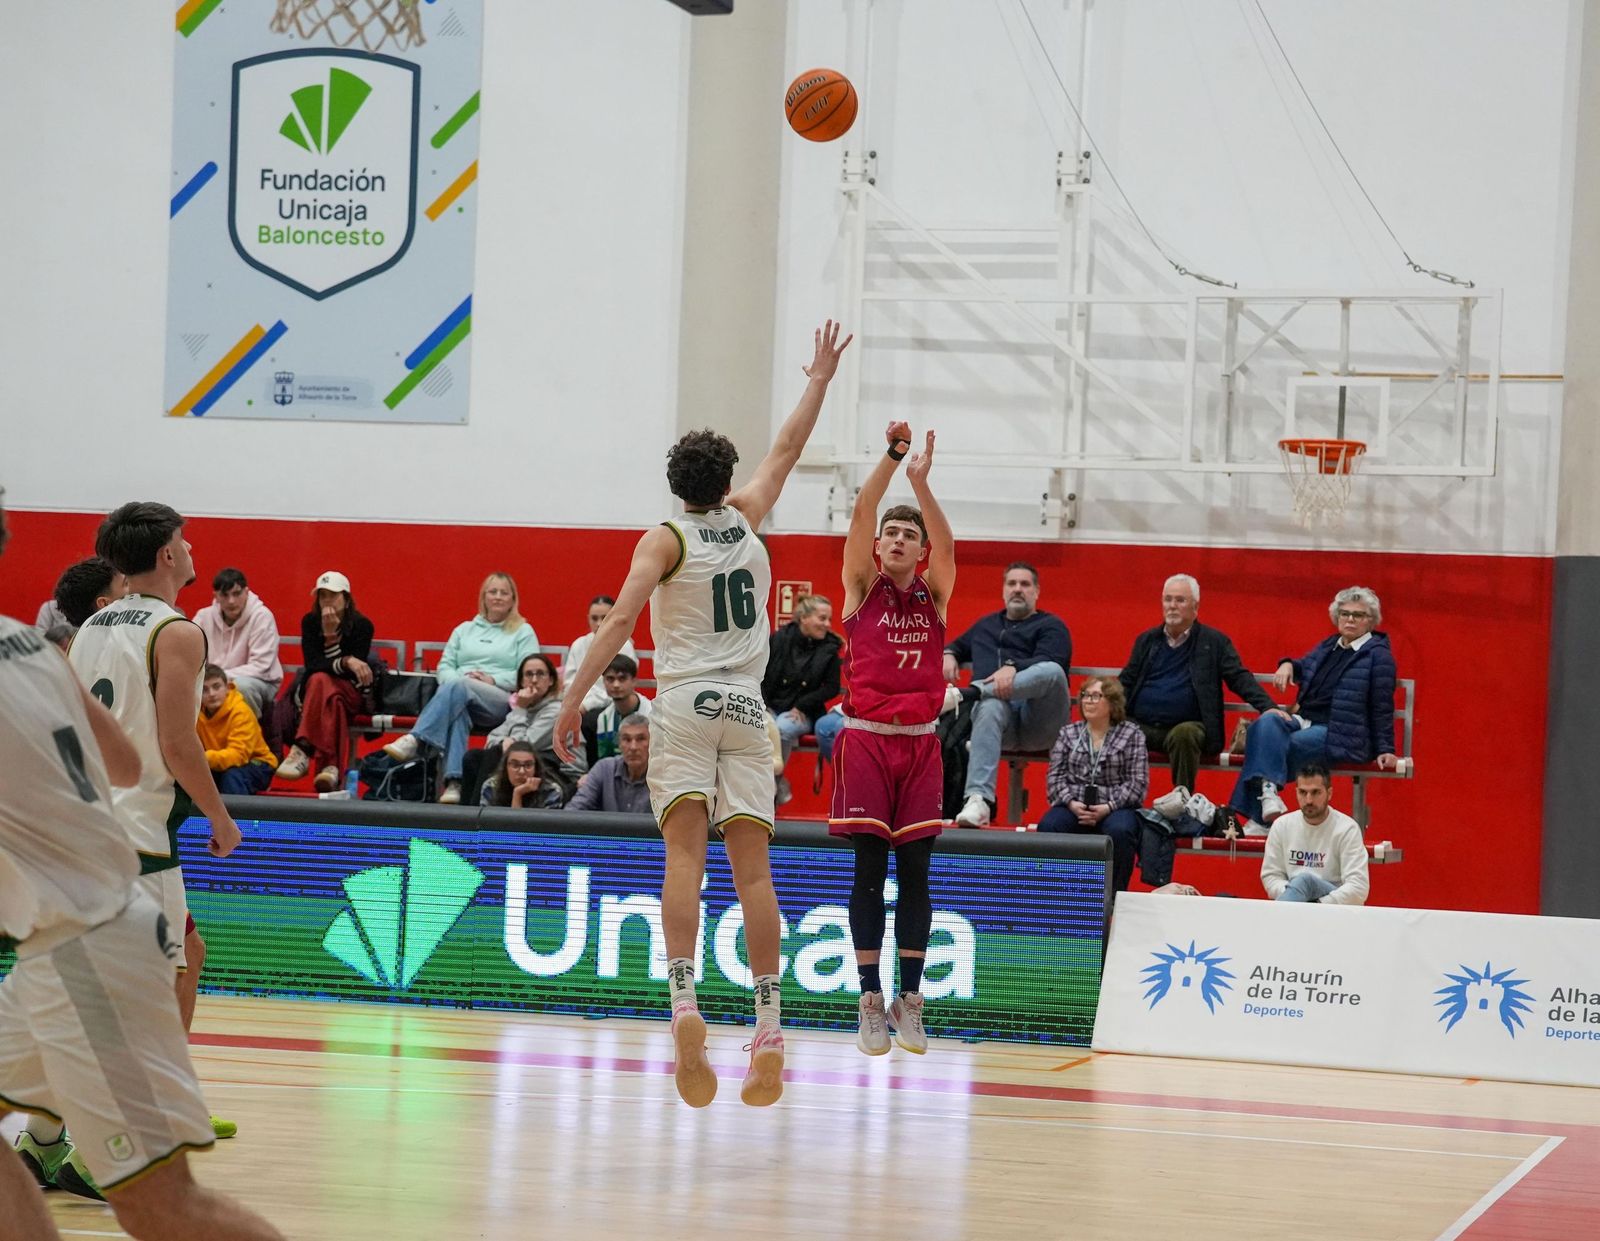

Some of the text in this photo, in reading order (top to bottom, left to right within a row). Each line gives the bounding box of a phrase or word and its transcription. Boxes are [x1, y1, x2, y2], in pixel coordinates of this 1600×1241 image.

[787, 76, 826, 107] Wilson
[260, 167, 385, 192] Fundación
[278, 198, 368, 227] Unicaja
[258, 224, 385, 246] Baloncesto
[712, 568, 756, 633] 16
[887, 632, 929, 643] LLEIDA
[896, 650, 922, 669] 77
[727, 703, 748, 715] DEL
[1290, 850, 1326, 861] TOMMY
[1249, 965, 1344, 986] Alhaurín
[1247, 983, 1361, 1006] de la Torre
[1243, 1003, 1304, 1018] Deportes
[1548, 1005, 1600, 1024] de la
